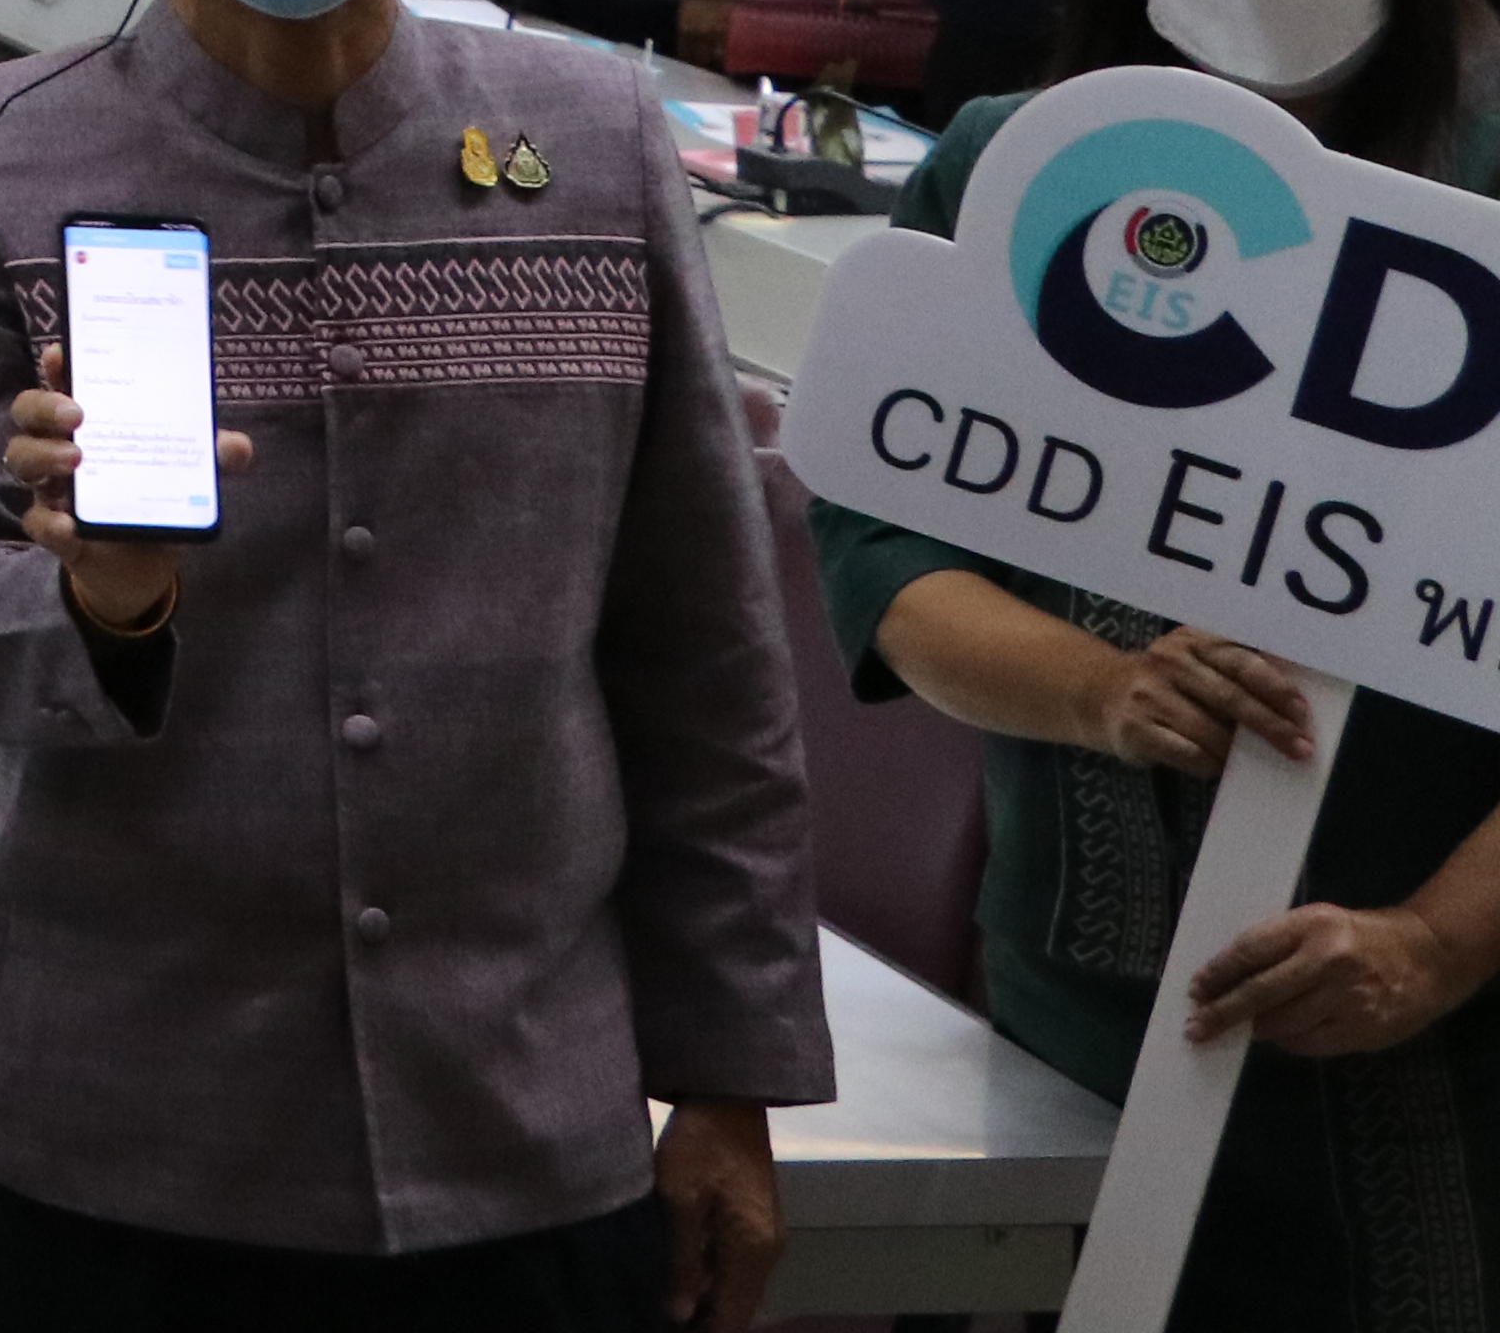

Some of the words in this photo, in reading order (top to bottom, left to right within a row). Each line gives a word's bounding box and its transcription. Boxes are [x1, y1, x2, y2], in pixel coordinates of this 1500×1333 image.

[1103, 268, 1195, 331] EIS
[870, 388, 1105, 525] CDD
[1146, 449, 1385, 618] EIS
[1414, 578, 1500, 673] พ
